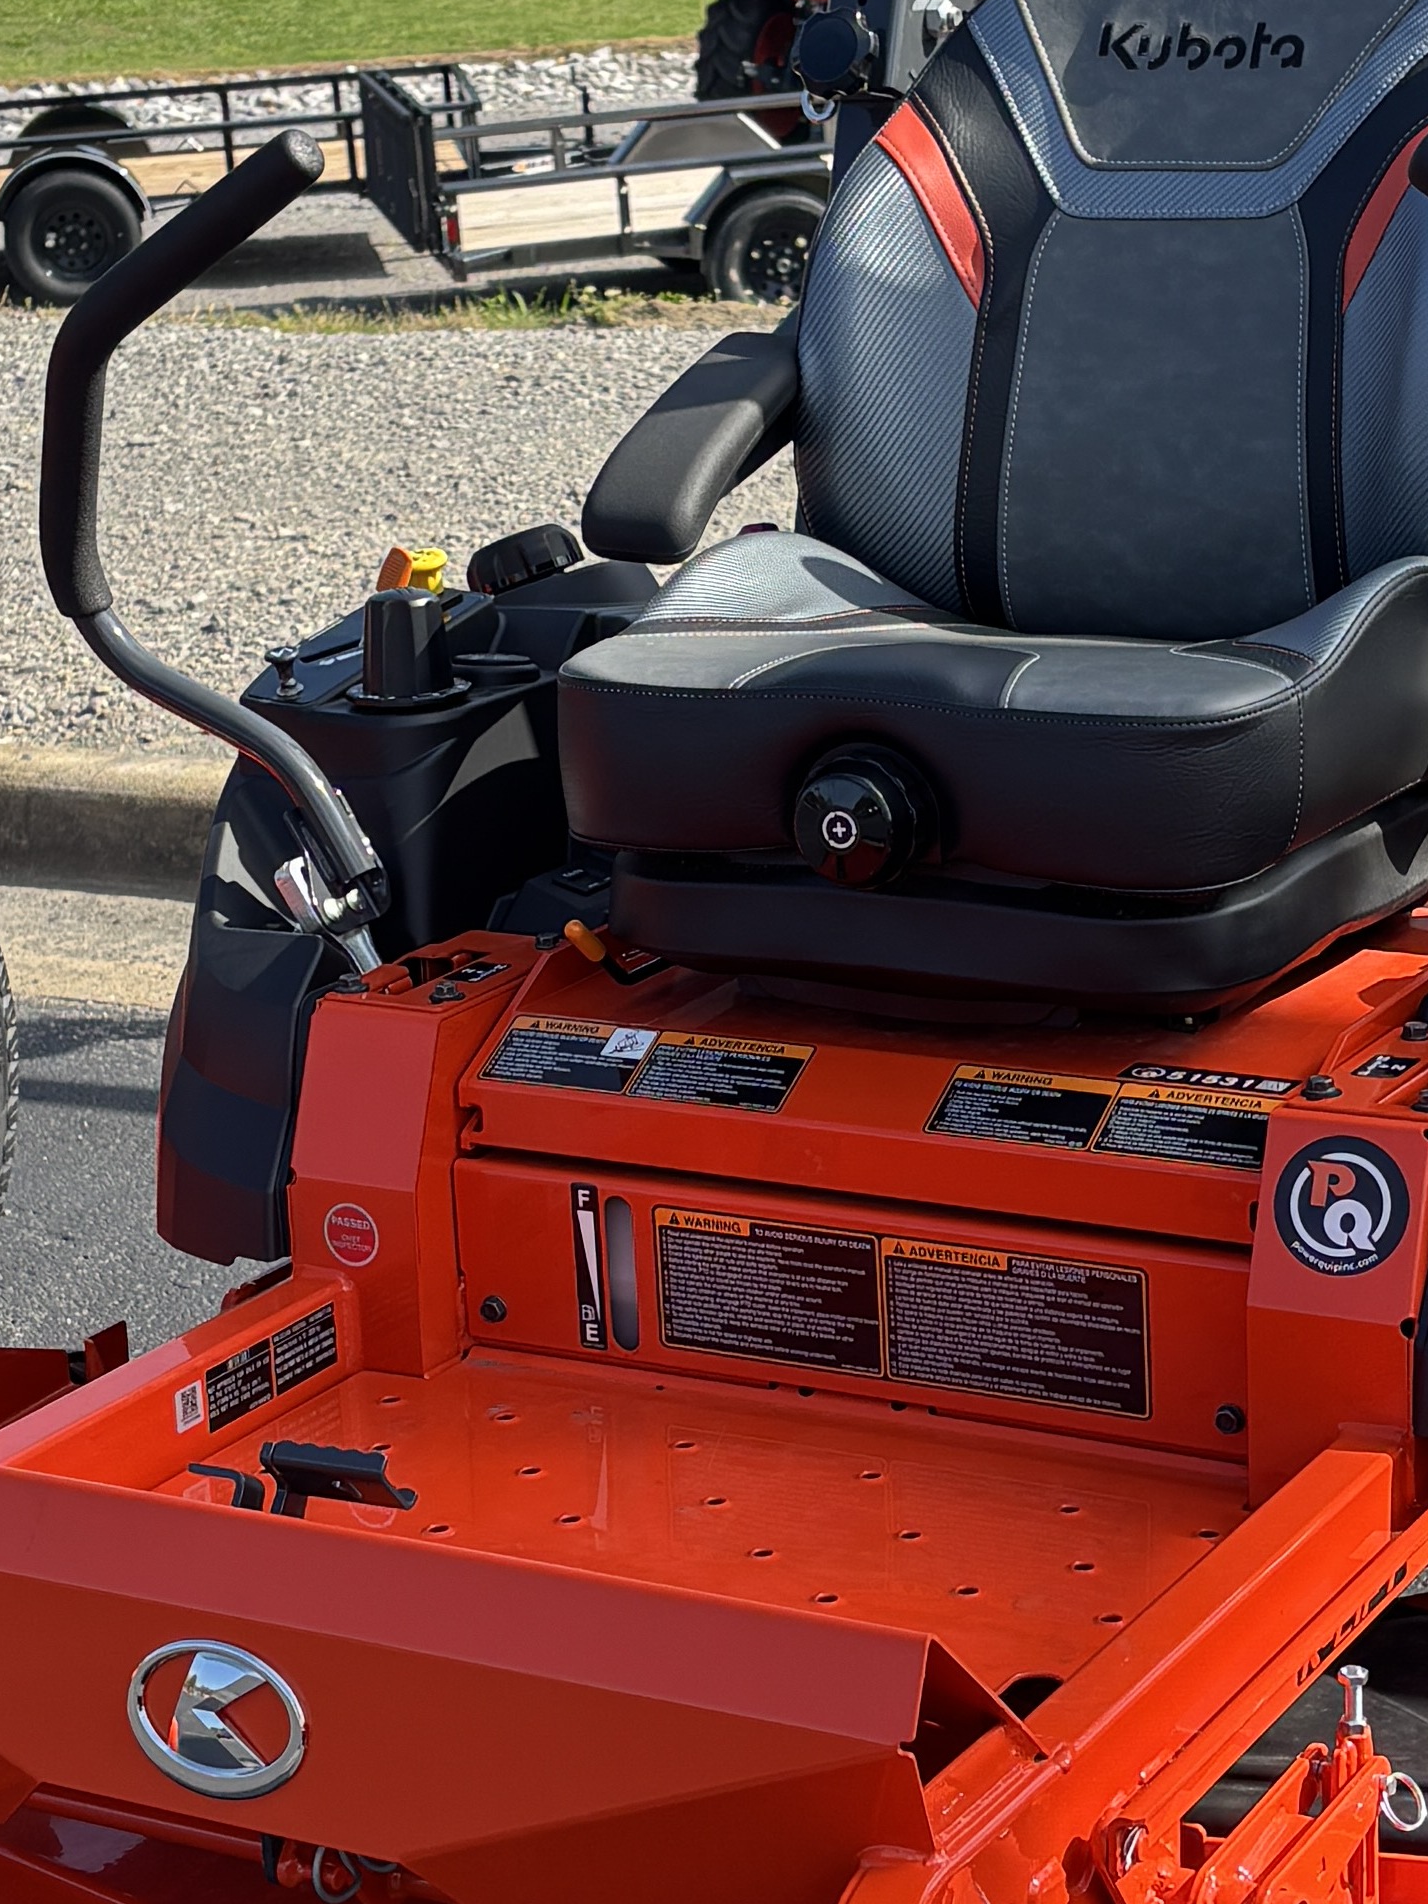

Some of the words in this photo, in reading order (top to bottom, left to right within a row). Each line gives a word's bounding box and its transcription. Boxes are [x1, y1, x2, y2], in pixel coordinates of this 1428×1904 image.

[1098, 21, 1305, 70] Kubota
[545, 1020, 600, 1035] WARNING
[700, 1036, 786, 1055] ADVERTENCIA
[991, 1071, 1053, 1086] WARNING
[1165, 1090, 1263, 1109] ADVERTENCIA
[577, 1189, 590, 1207] F
[331, 1216, 370, 1231] PASSED
[683, 1215, 741, 1233] WARNING
[909, 1245, 1001, 1268] ADVERTENCIA
[586, 1324, 599, 1342] E
